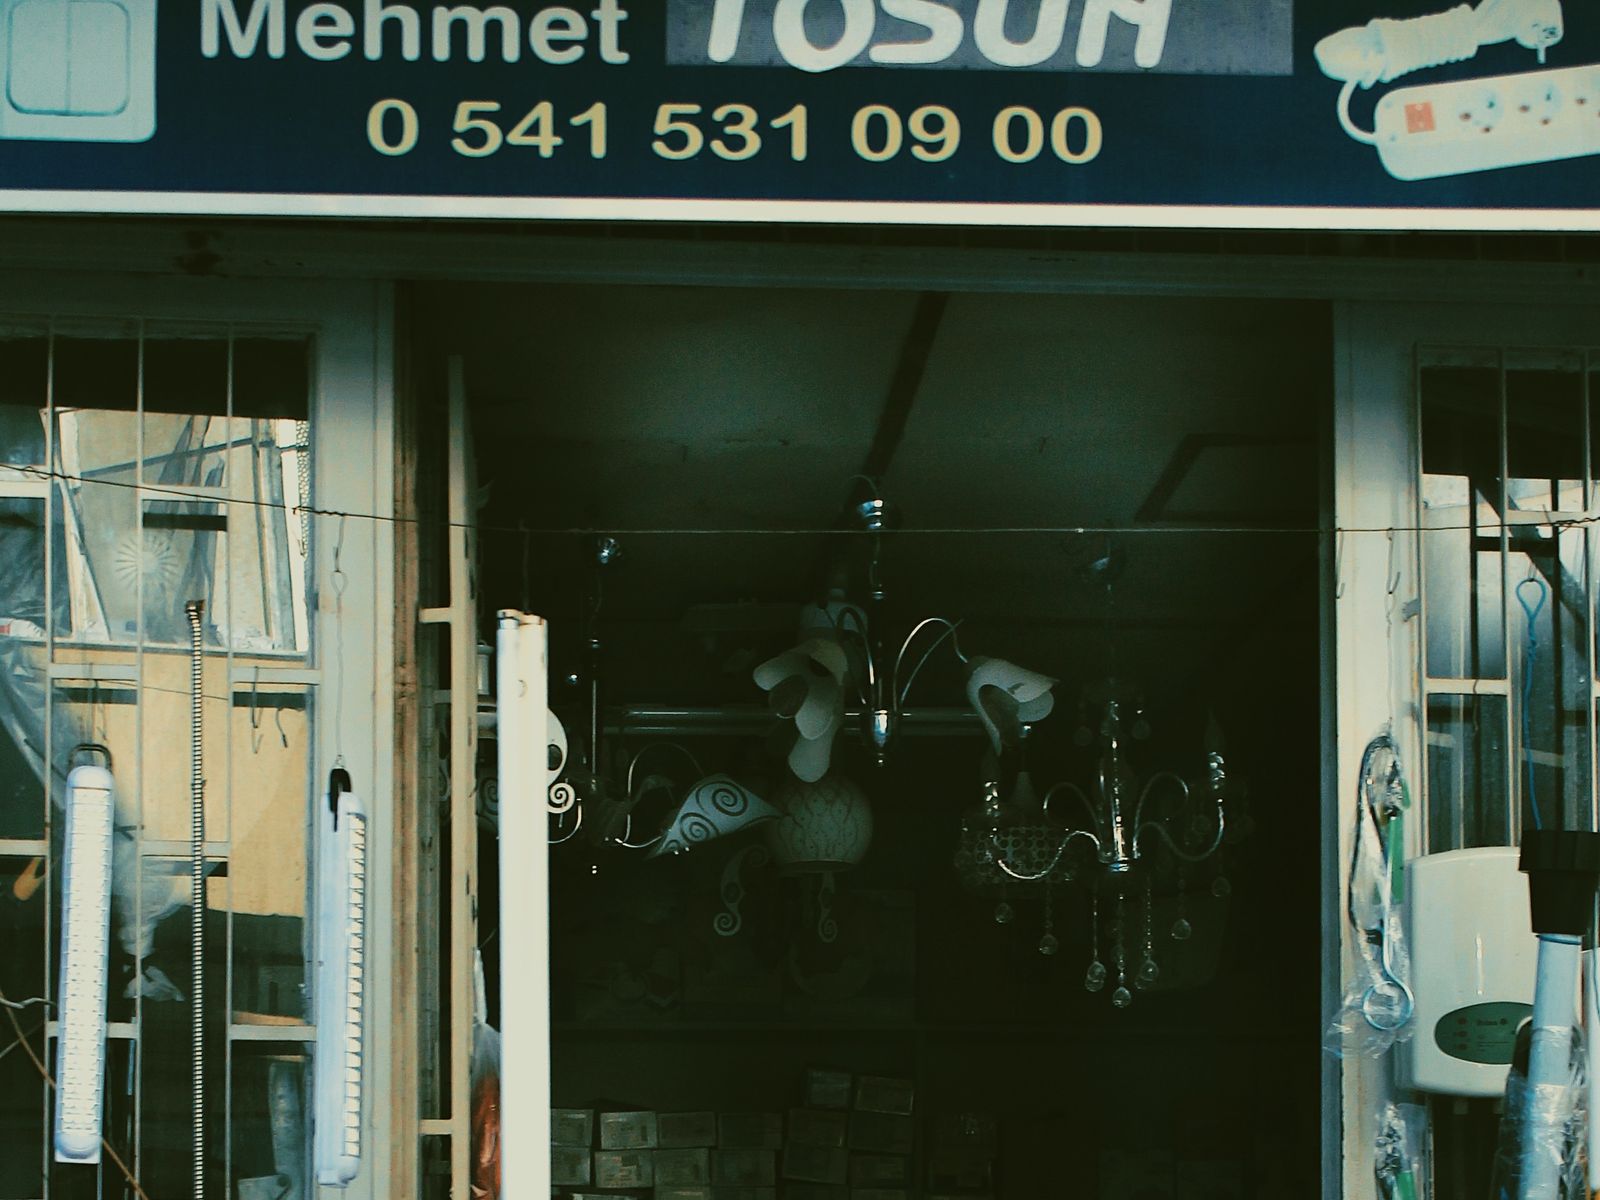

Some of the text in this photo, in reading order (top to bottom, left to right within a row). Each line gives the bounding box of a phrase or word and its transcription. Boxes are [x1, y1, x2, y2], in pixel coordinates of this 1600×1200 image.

[201, 0, 630, 65] Mehmet
[367, 98, 1103, 164] 0 541 531 09 00
